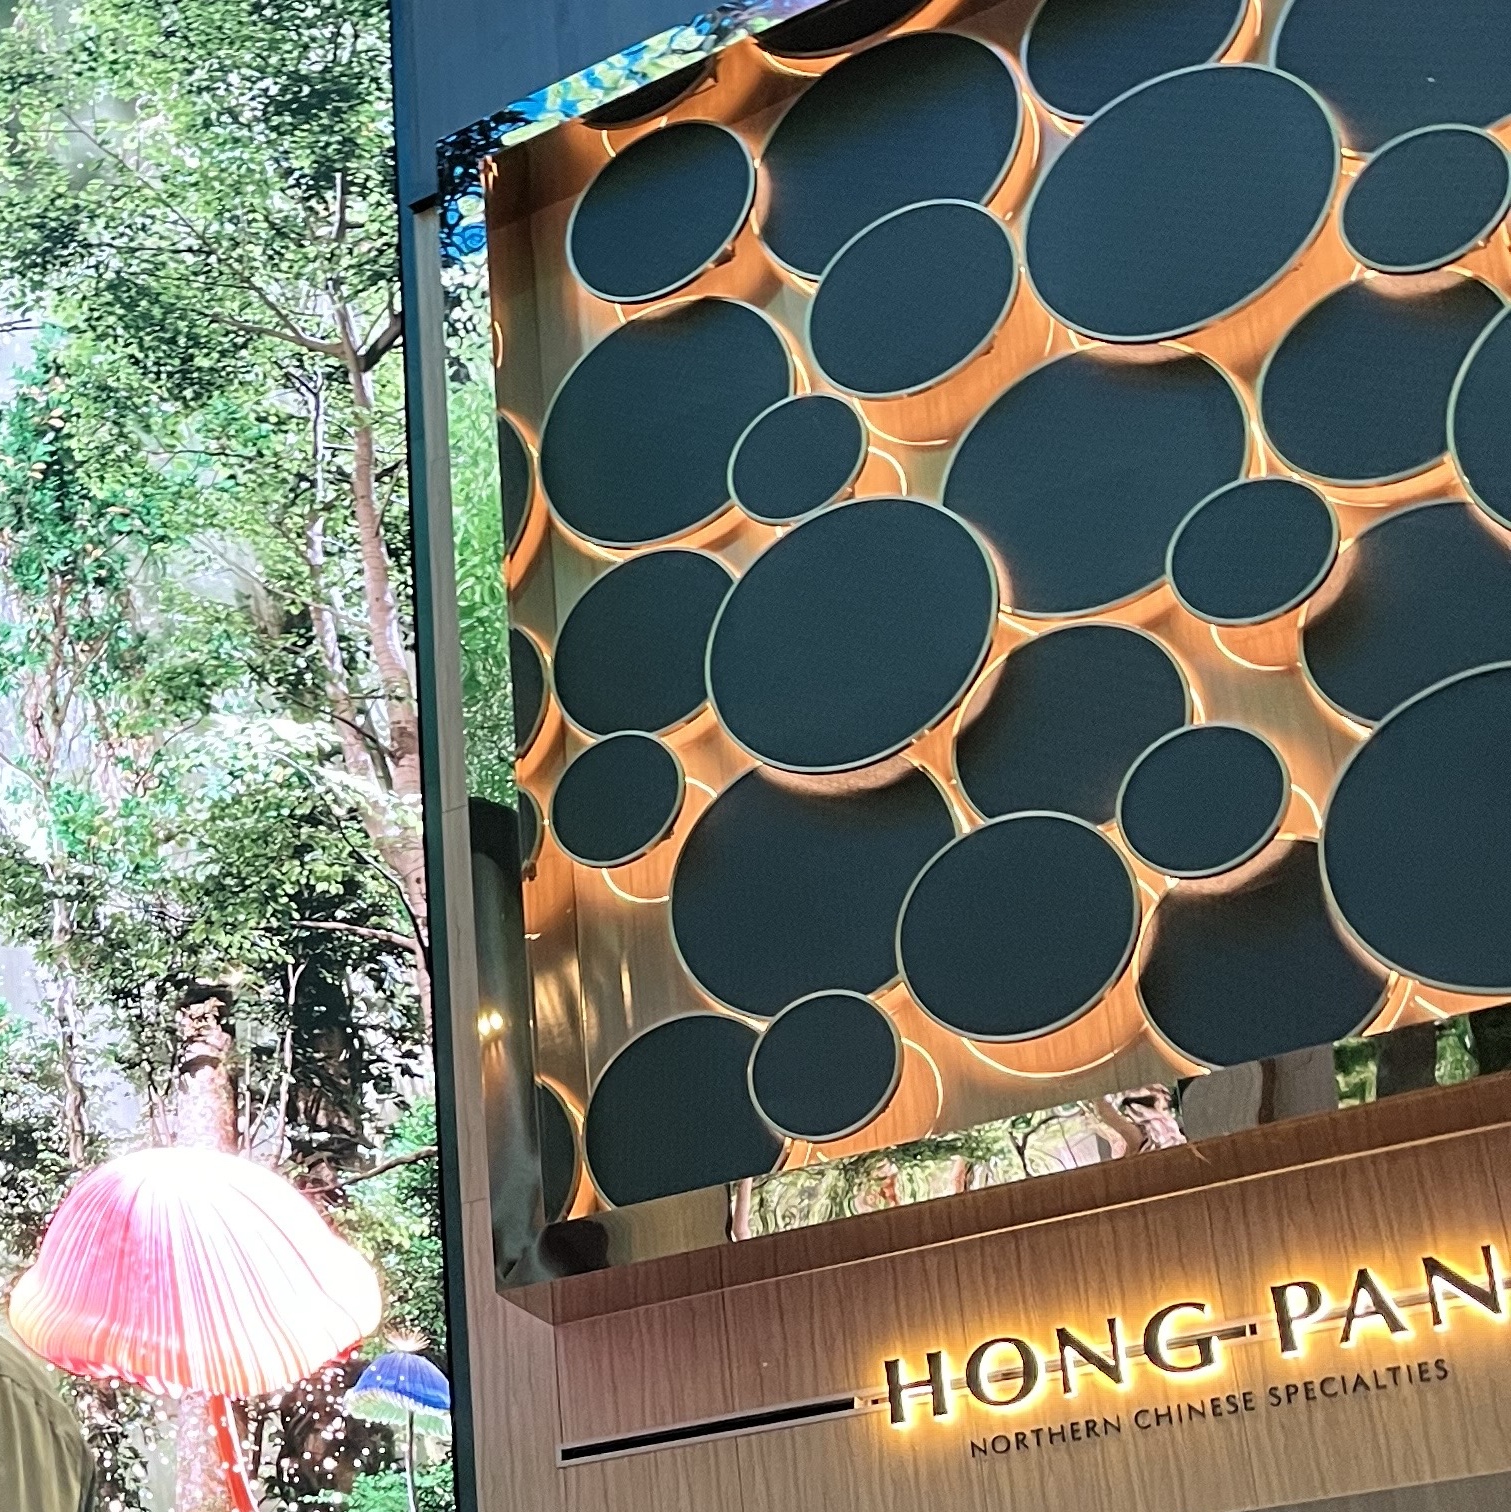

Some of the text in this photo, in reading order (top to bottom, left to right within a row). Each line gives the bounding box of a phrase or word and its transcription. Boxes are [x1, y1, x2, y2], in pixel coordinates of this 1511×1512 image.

[884, 1244, 1503, 1424] HONG PAN
[970, 1358, 1450, 1458] NORTHERN CHINESE SPECIALTIES
